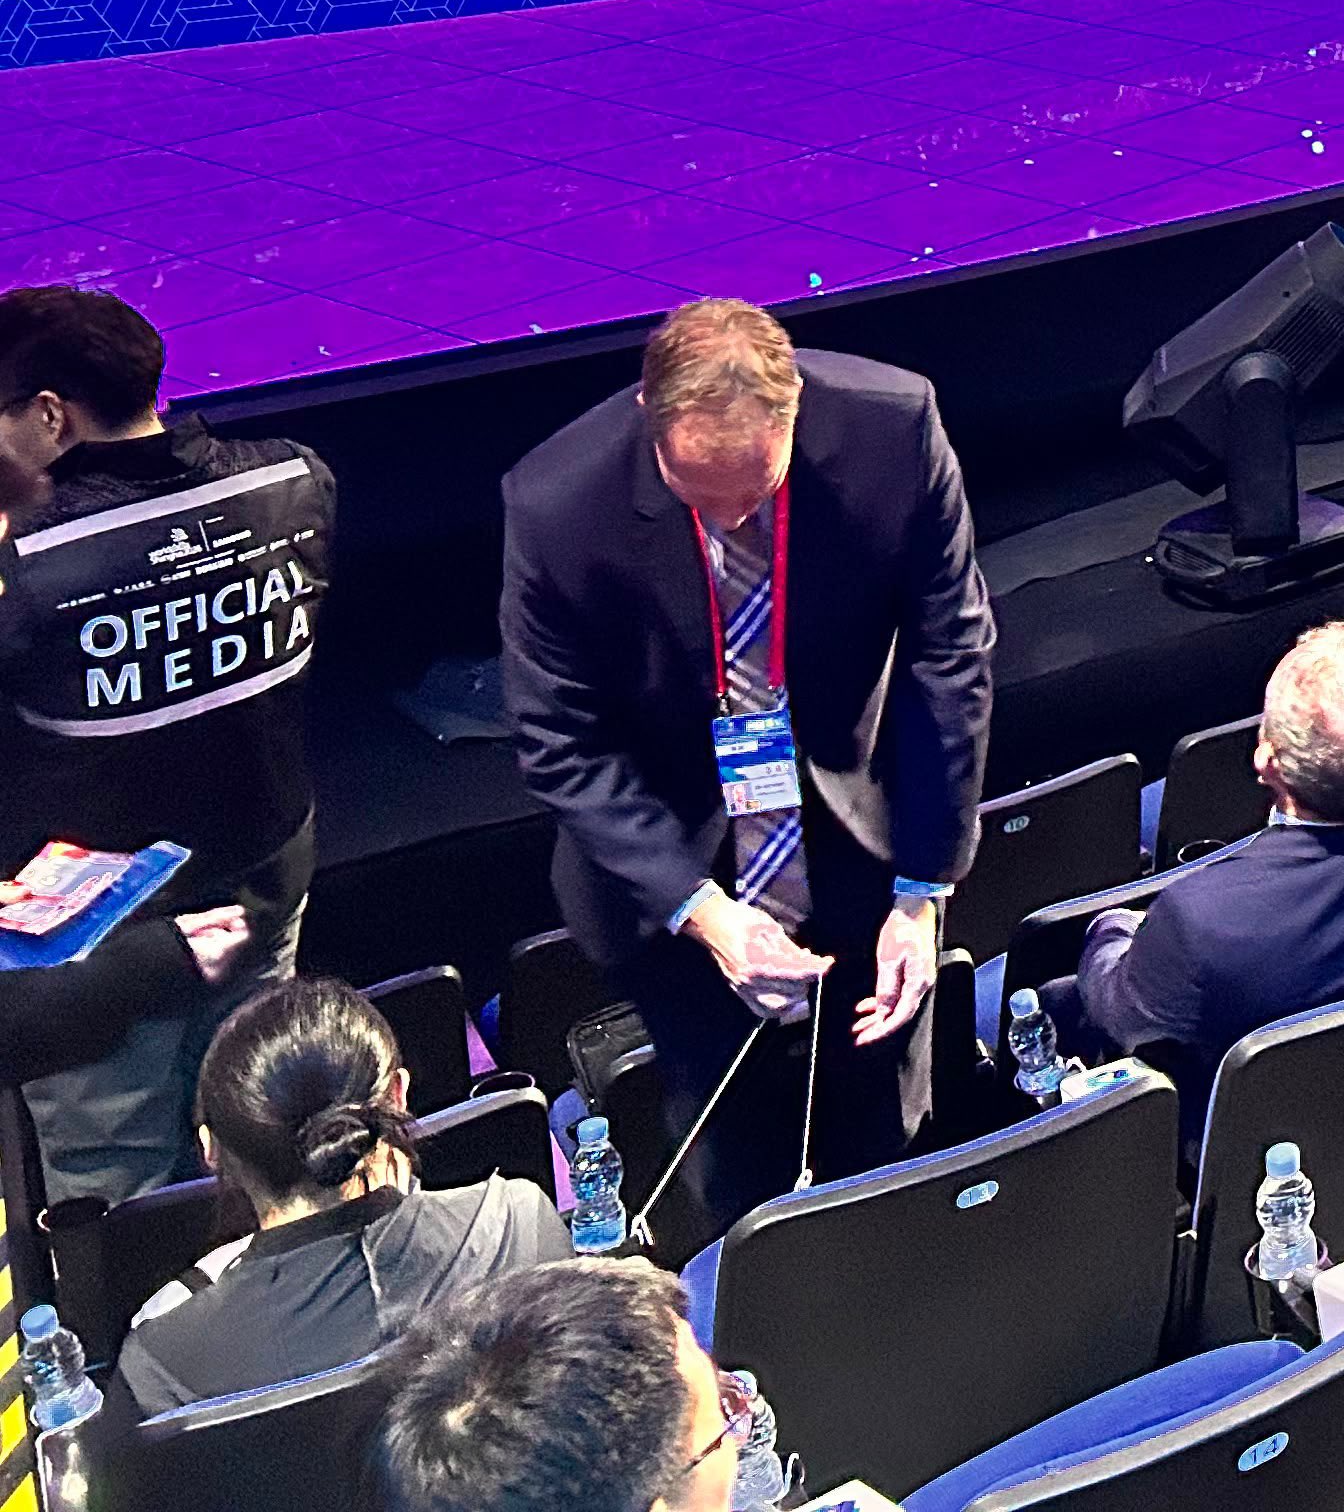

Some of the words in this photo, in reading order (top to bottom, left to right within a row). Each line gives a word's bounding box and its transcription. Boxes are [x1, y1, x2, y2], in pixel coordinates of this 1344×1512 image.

[80, 560, 313, 658] OFFICIAL
[86, 605, 312, 707] MEDIA
[1009, 818, 1025, 832] 10
[1251, 1438, 1279, 1463] 14
